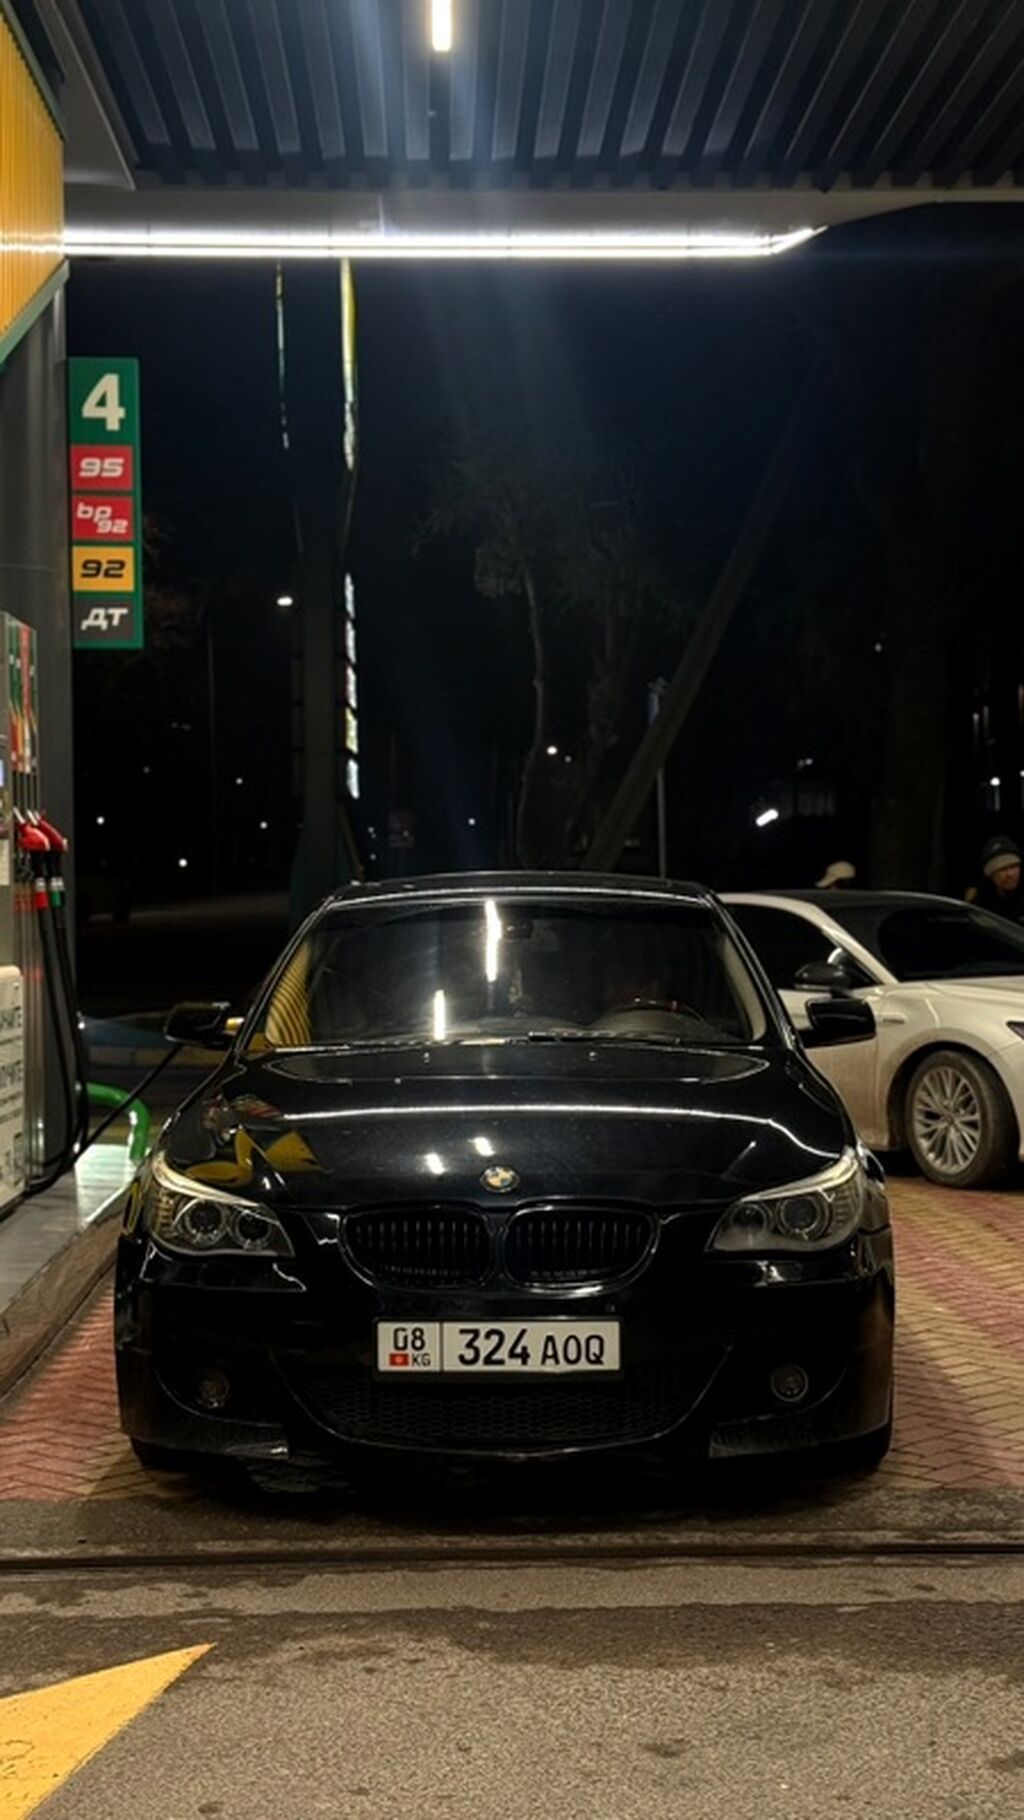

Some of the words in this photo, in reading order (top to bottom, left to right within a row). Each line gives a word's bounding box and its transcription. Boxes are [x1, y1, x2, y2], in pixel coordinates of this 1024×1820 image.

[81, 373, 126, 431] 4
[79, 457, 125, 478] 95
[96, 519, 129, 534] 92
[80, 559, 126, 579] 92
[81, 608, 128, 630] ДТ
[393, 1327, 426, 1351] 08
[458, 1328, 531, 1366] 324
[541, 1334, 605, 1366] AOQ
[411, 1353, 431, 1367] KG
